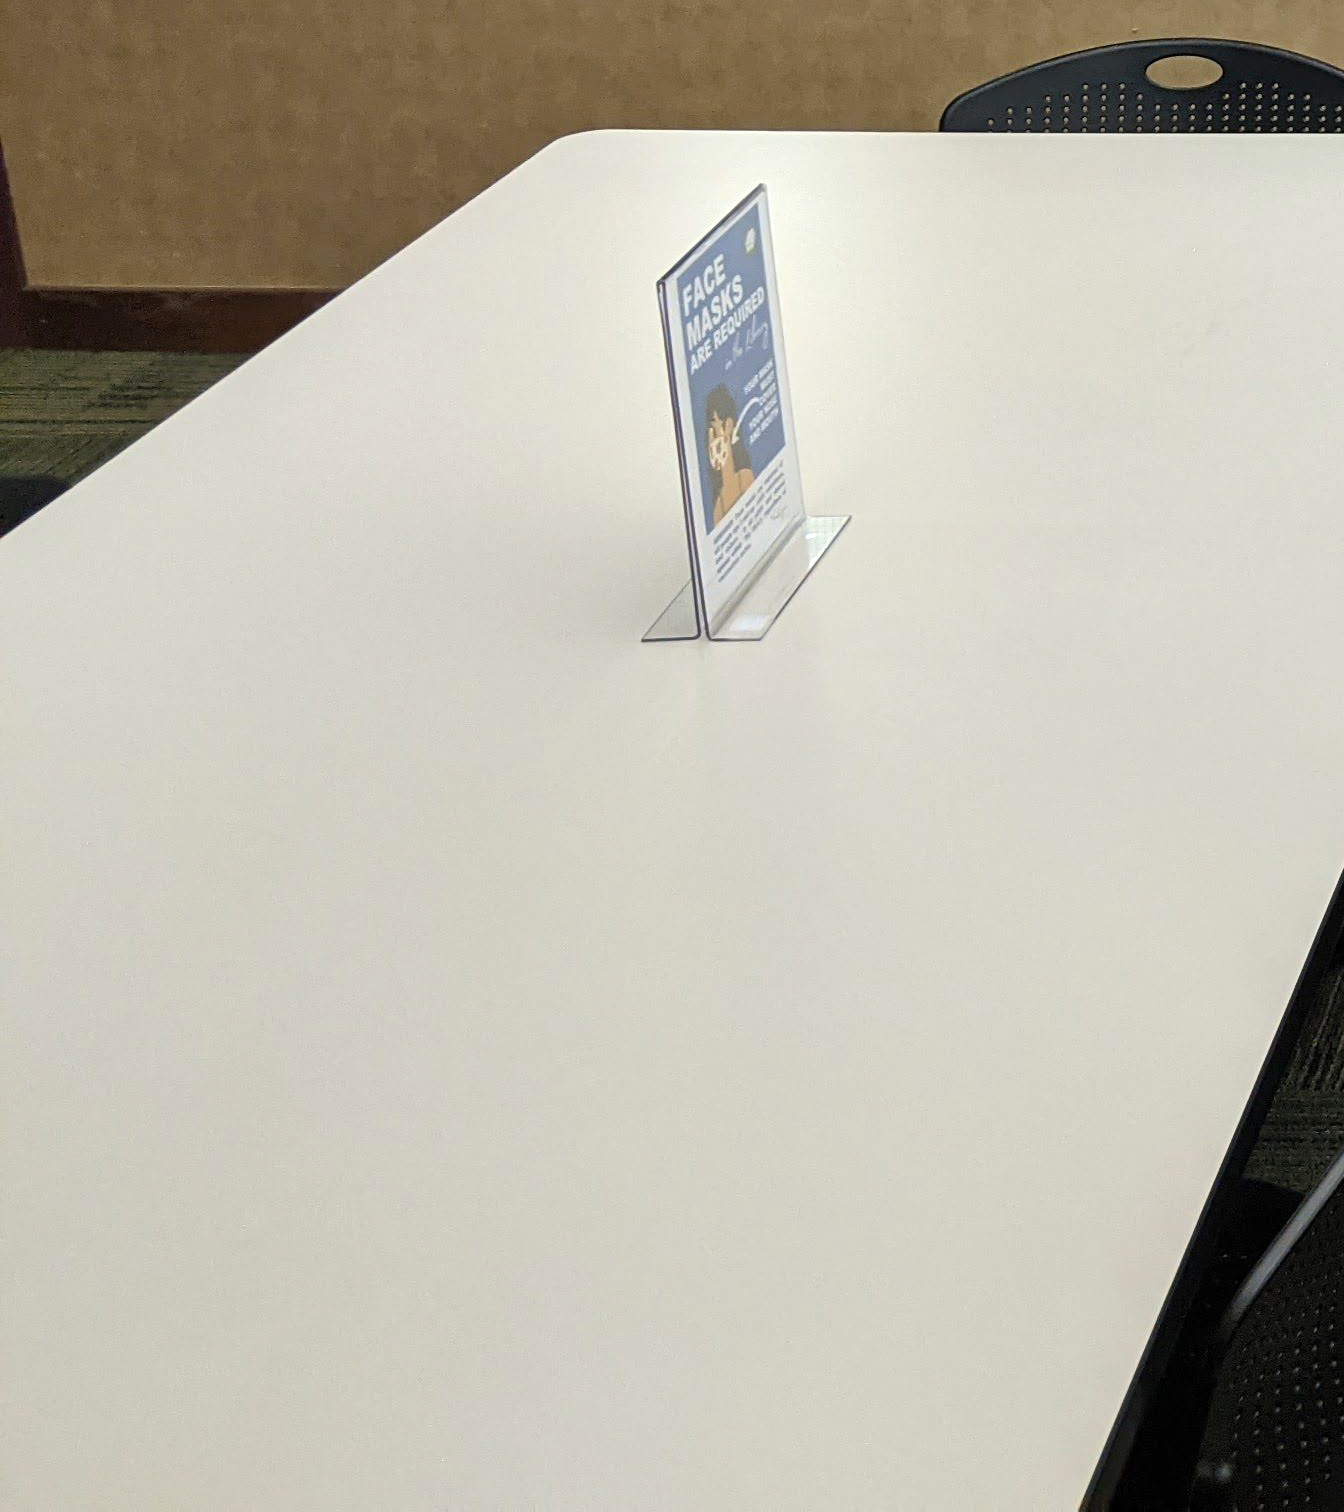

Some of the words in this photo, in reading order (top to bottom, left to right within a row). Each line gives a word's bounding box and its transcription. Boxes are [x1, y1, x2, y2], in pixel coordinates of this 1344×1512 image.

[682, 254, 727, 317] FACE
[686, 275, 744, 350] MASKS
[690, 339, 714, 376] ARE
[714, 286, 765, 346] REQUIRED
